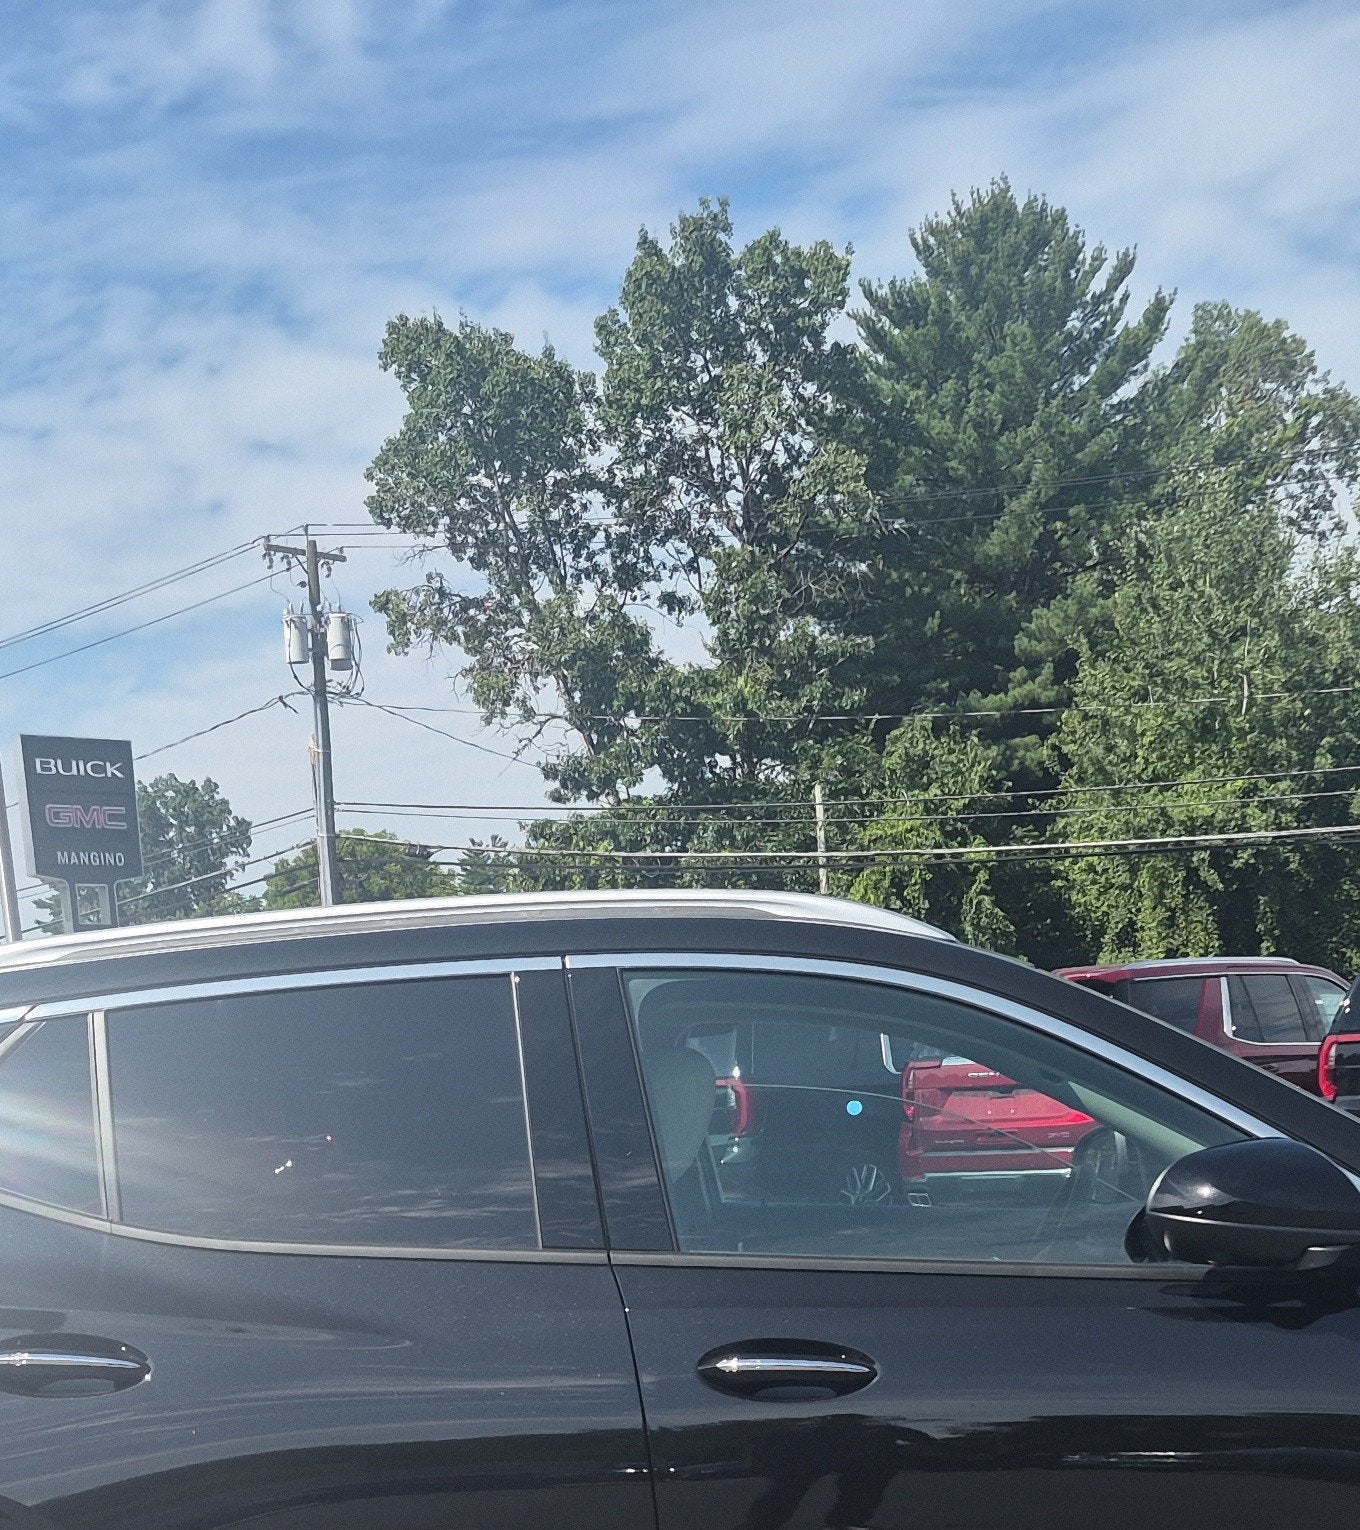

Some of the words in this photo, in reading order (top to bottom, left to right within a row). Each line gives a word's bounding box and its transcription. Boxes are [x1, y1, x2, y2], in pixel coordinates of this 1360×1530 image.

[35, 757, 125, 779] BUICK
[44, 803, 127, 830] GMC
[57, 850, 125, 867] MANGINO
